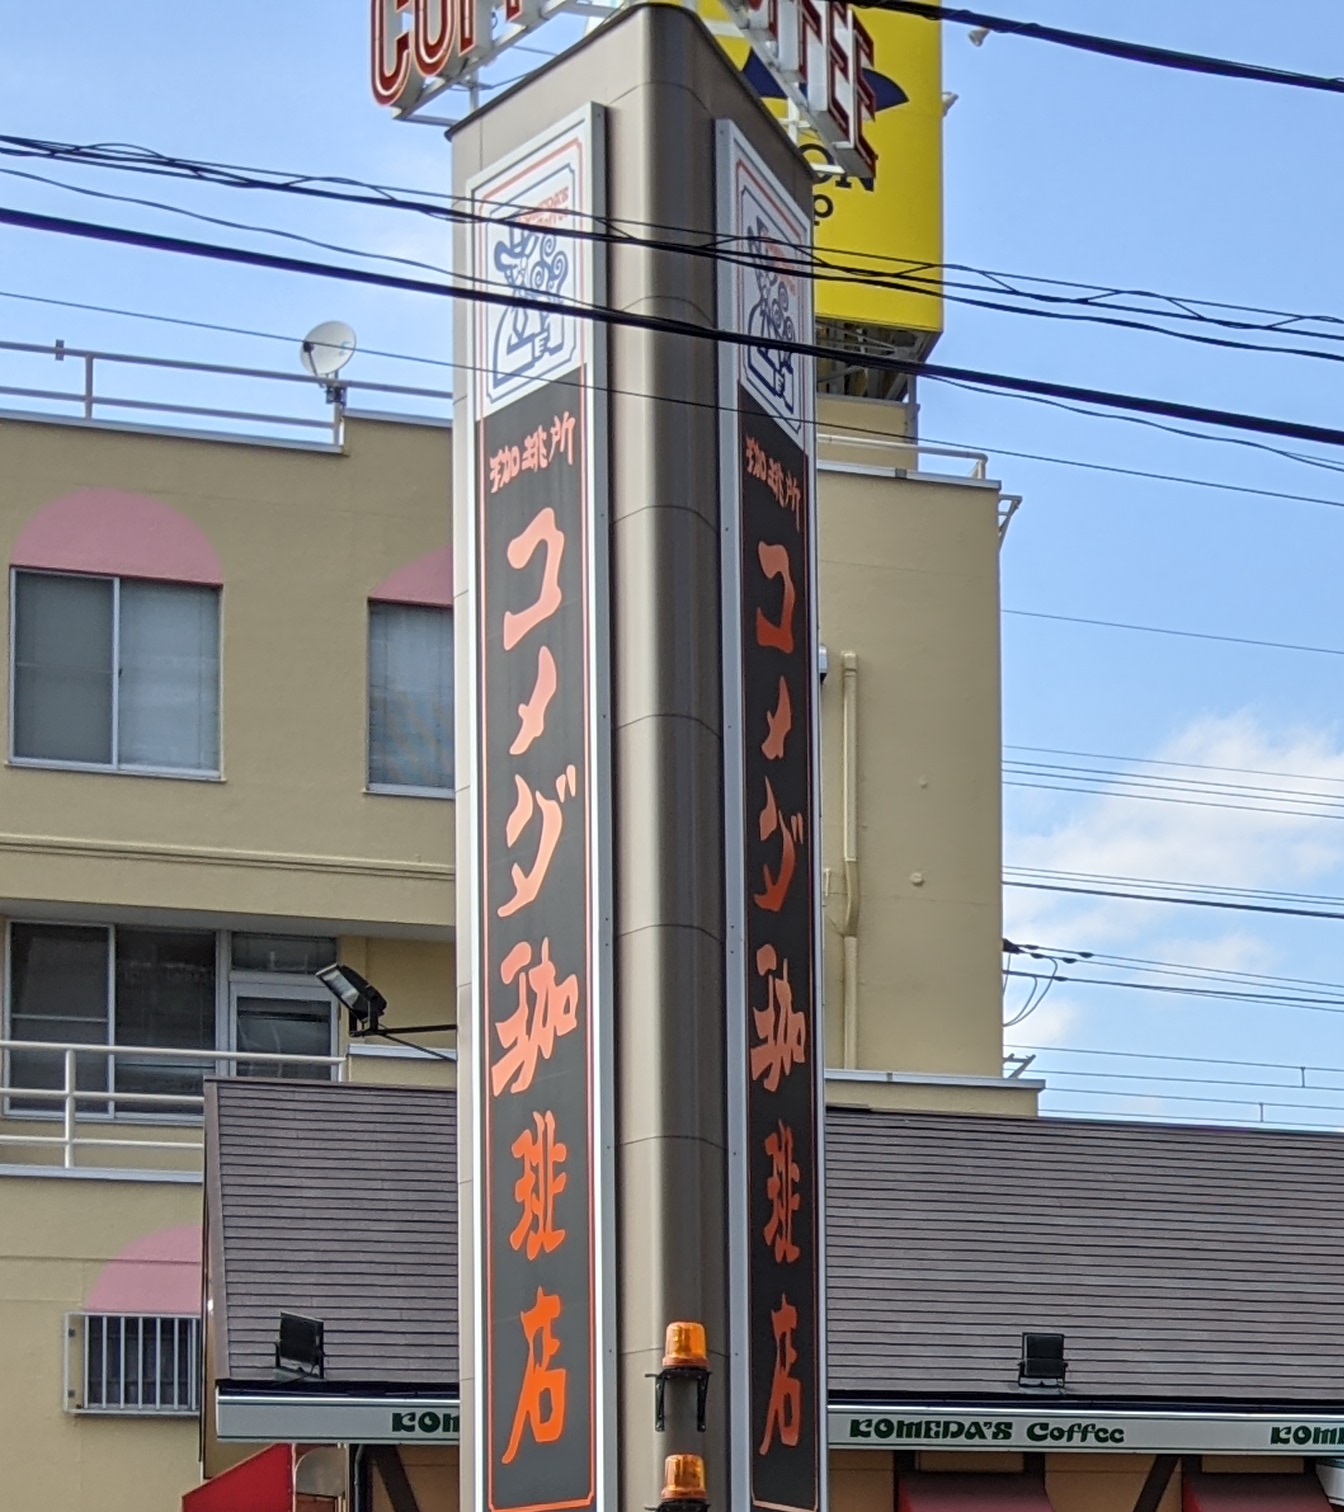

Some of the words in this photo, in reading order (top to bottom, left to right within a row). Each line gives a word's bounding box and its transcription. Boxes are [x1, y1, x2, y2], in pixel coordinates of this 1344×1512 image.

[490, 506, 580, 1465] コメダ珈琲店
[750, 541, 806, 1456] コメダ珈琲店
[849, 1417, 1014, 1441] KOMEDA'S
[1026, 1421, 1126, 1445] Coffee
